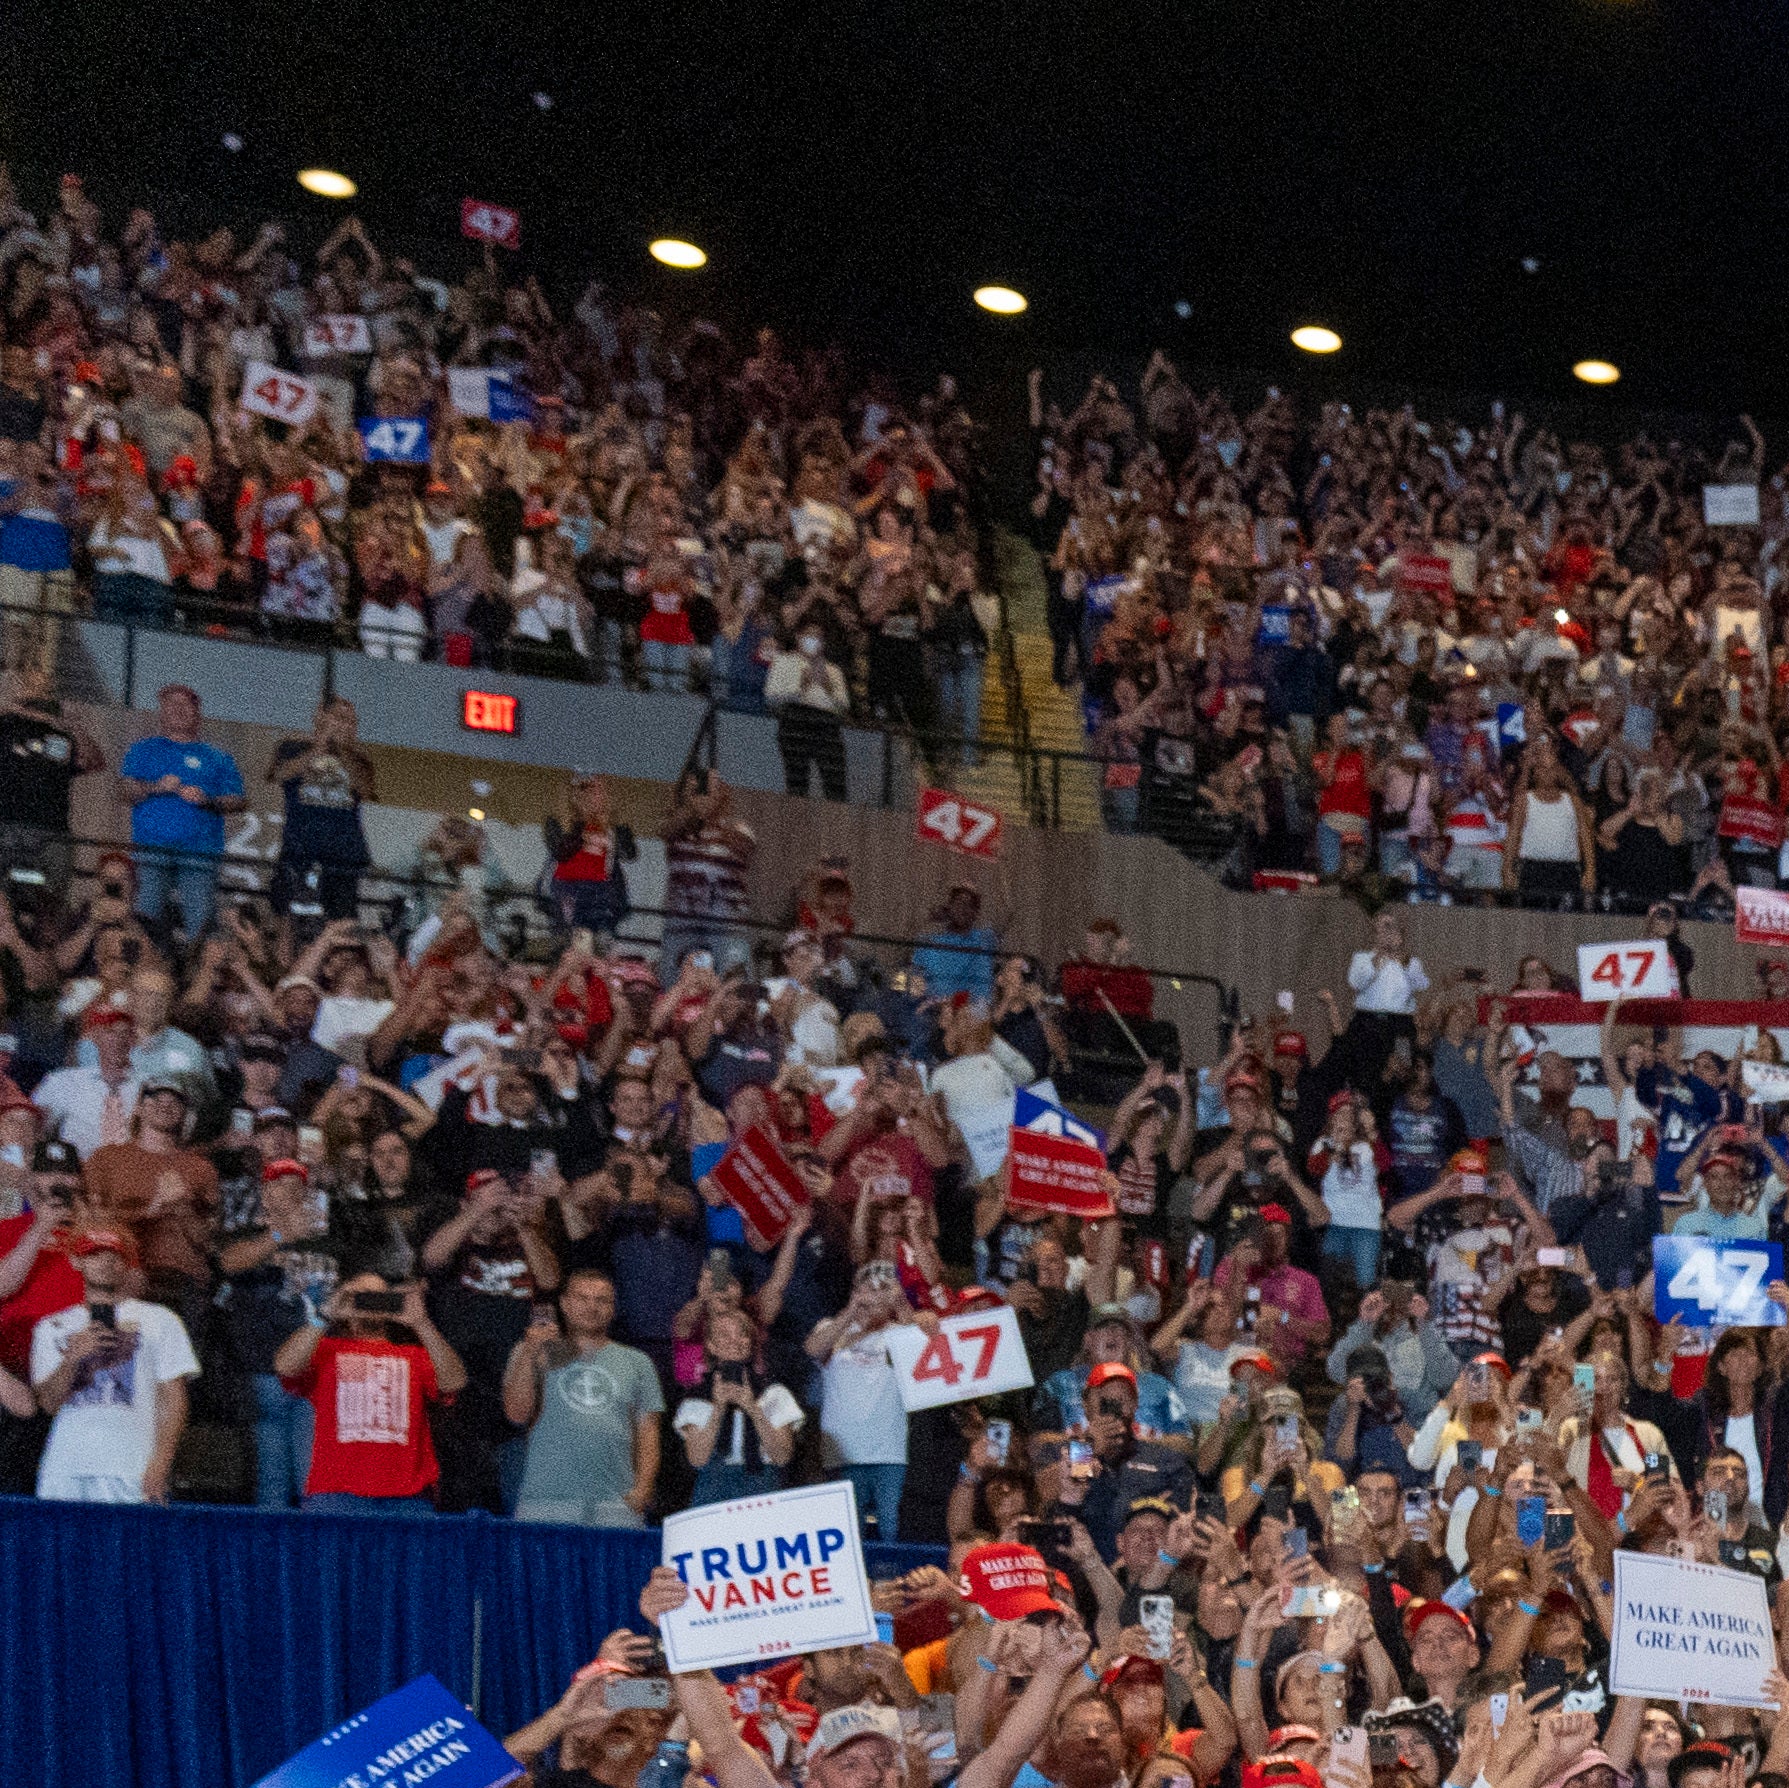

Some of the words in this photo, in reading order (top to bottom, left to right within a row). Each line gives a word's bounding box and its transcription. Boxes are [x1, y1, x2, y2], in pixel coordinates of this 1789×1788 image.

[366, 422, 422, 454] 47
[465, 690, 516, 732] EXIT
[923, 801, 994, 846] 47
[1592, 951, 1655, 987] 47
[1667, 1249, 1769, 1311] 47
[913, 1324, 1000, 1384] 47
[686, 1528, 845, 1590] TRUMP
[980, 1559, 1008, 1574] MAKE
[694, 1567, 832, 1612] VANCE
[1628, 1602, 1680, 1623] MAKE
[1688, 1610, 1764, 1636] AMERICA
[758, 1640, 792, 1654] 2024
[1636, 1630, 1698, 1652] GREAT
[1704, 1636, 1760, 1658] AGAIN
[1682, 1688, 1710, 1698] 2024
[369, 1716, 467, 1786] AMERICA
